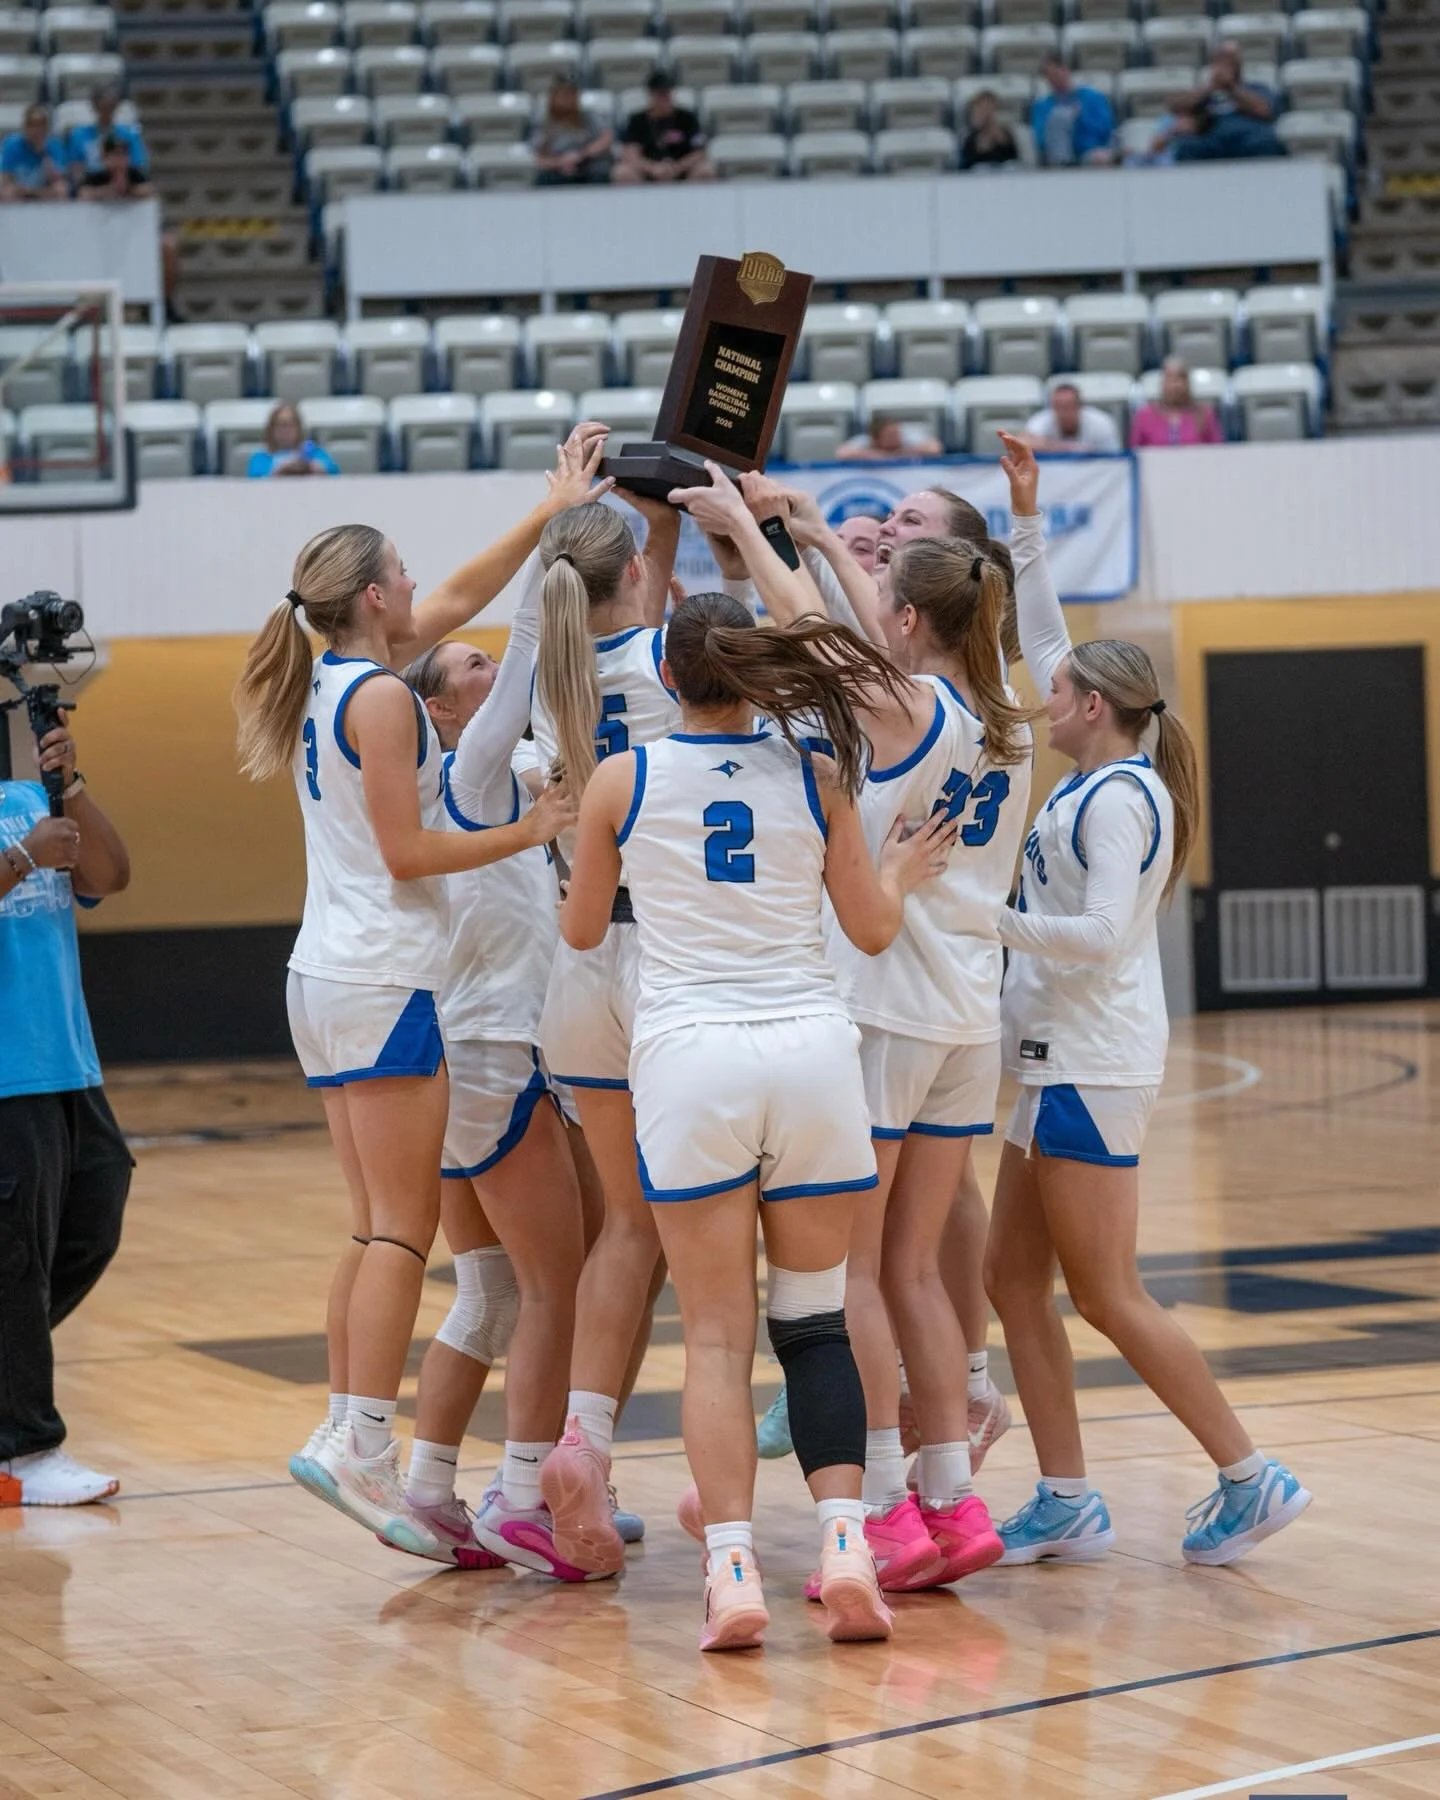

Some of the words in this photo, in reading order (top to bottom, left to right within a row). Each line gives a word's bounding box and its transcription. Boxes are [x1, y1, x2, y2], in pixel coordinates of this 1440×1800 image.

[741, 257, 784, 283] NJCAA
[714, 358, 760, 384] CHAMPION
[718, 345, 762, 372] NATIONAL
[708, 388, 751, 411] BASKETBALL
[716, 382, 748, 400] WOMEN'S
[708, 397, 740, 415] DIVISION
[302, 717, 322, 802] 3
[703, 800, 755, 883] 2
